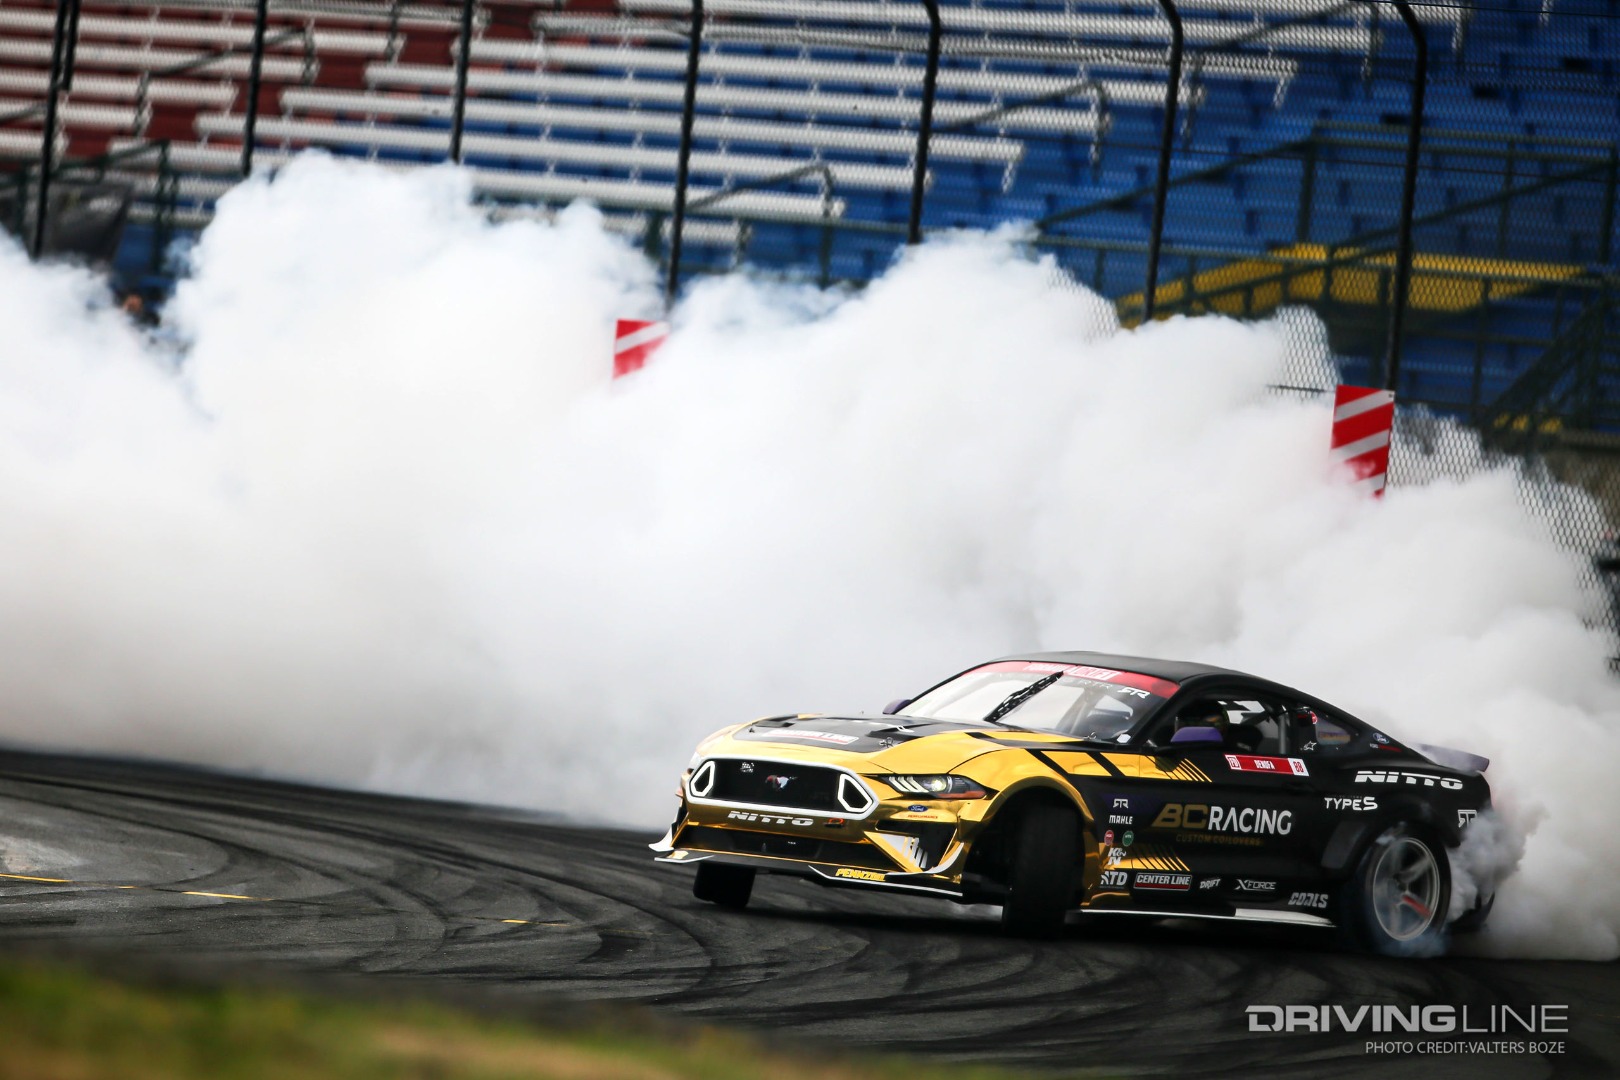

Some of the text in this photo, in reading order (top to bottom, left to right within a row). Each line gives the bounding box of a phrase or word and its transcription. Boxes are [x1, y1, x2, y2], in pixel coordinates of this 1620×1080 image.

[1354, 770, 1463, 790] NITTO
[727, 811, 814, 826] NITTO
[1109, 815, 1133, 825] MAHLE
[1136, 874, 1191, 885] CENTER LINE
